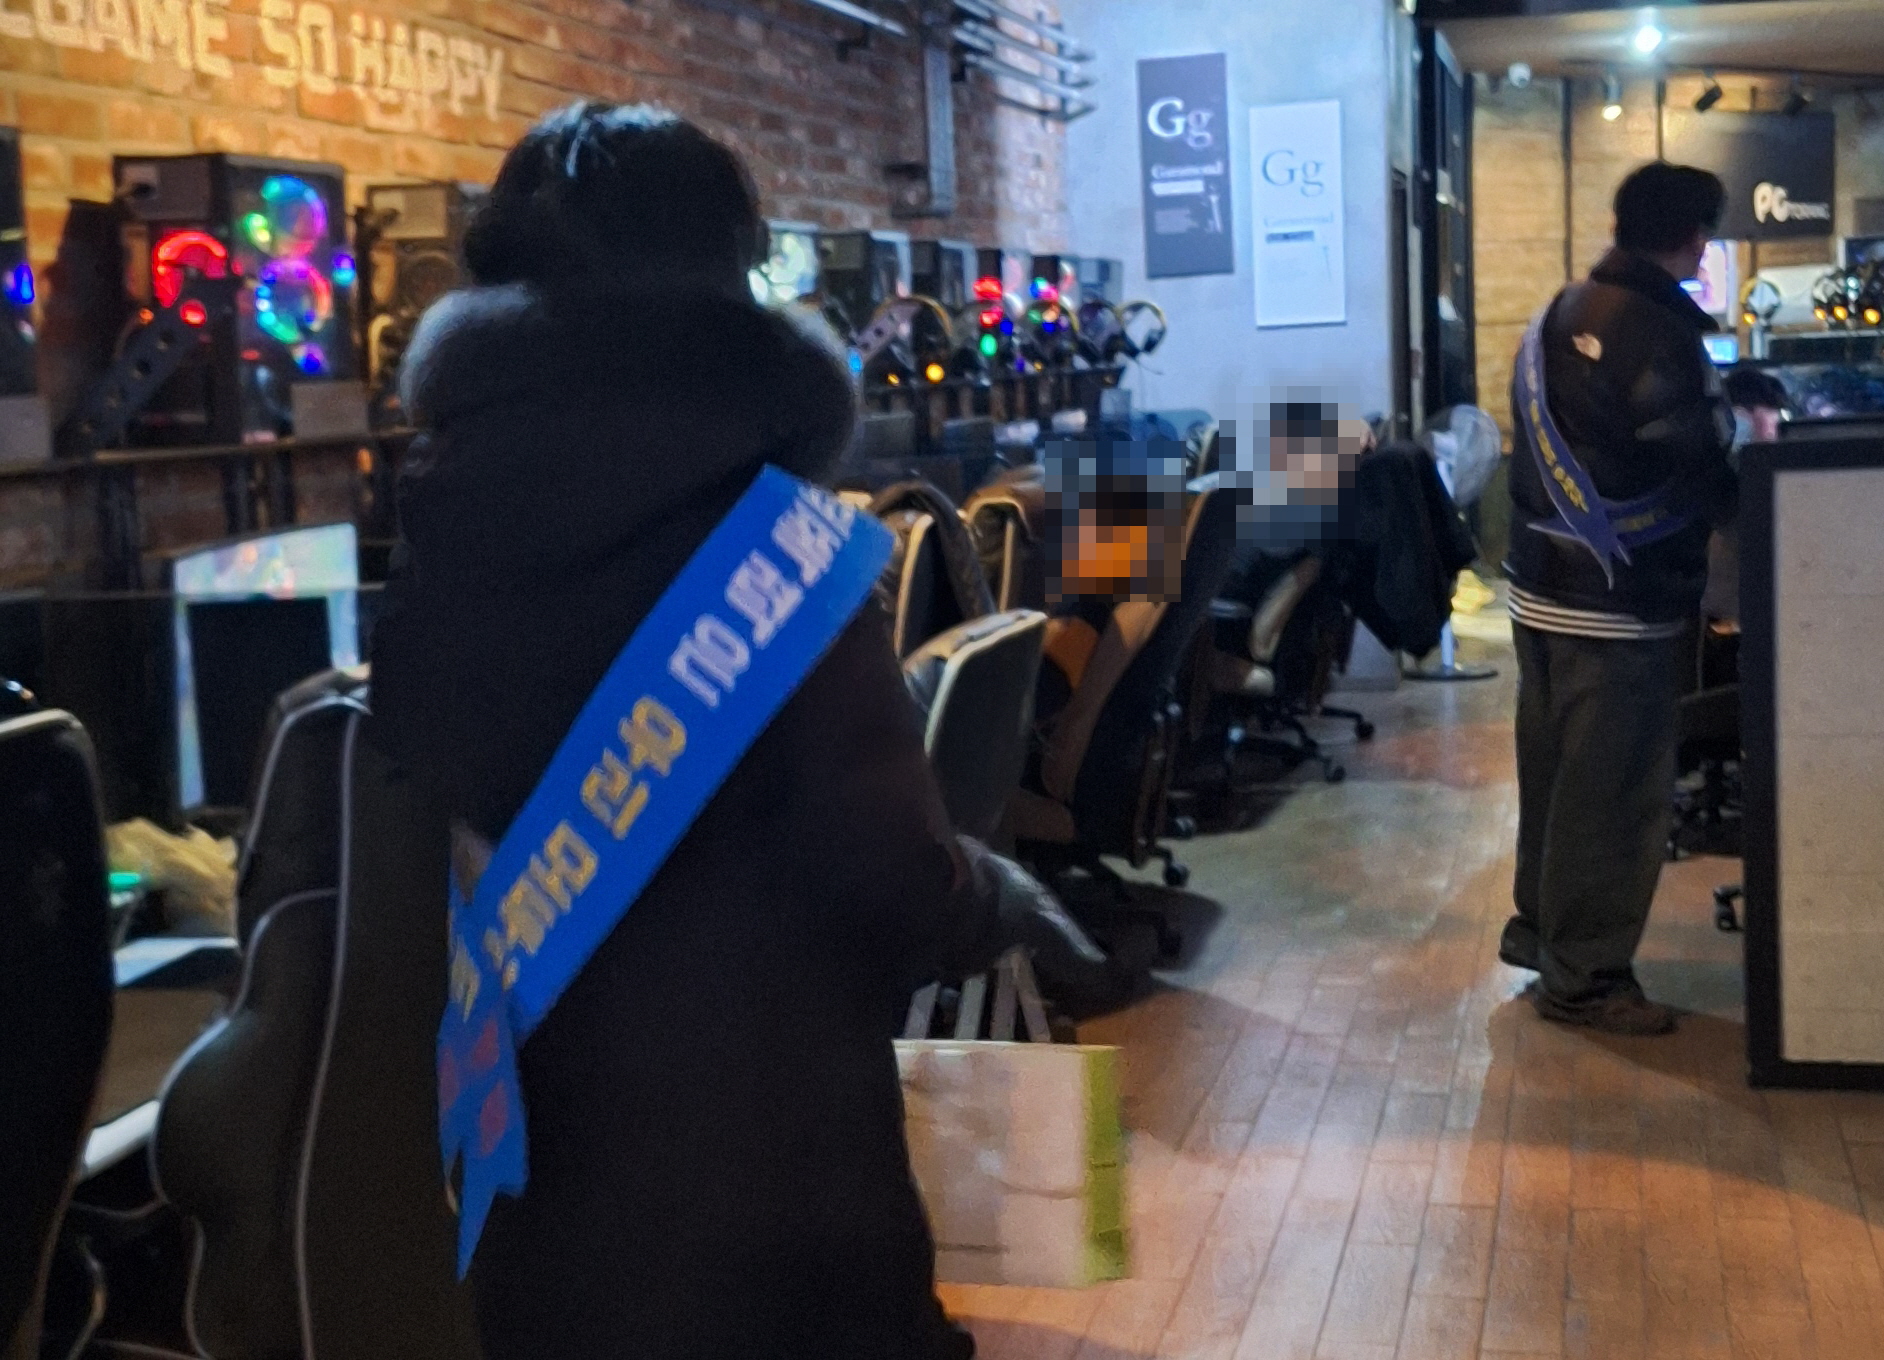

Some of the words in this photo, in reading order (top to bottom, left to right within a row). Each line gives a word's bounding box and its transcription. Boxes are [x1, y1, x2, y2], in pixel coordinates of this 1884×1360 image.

[349, 10, 503, 122] HAPPY
[1147, 96, 1215, 150] Gg
[1261, 149, 1326, 198] Gg
[580, 695, 690, 840] 우리
